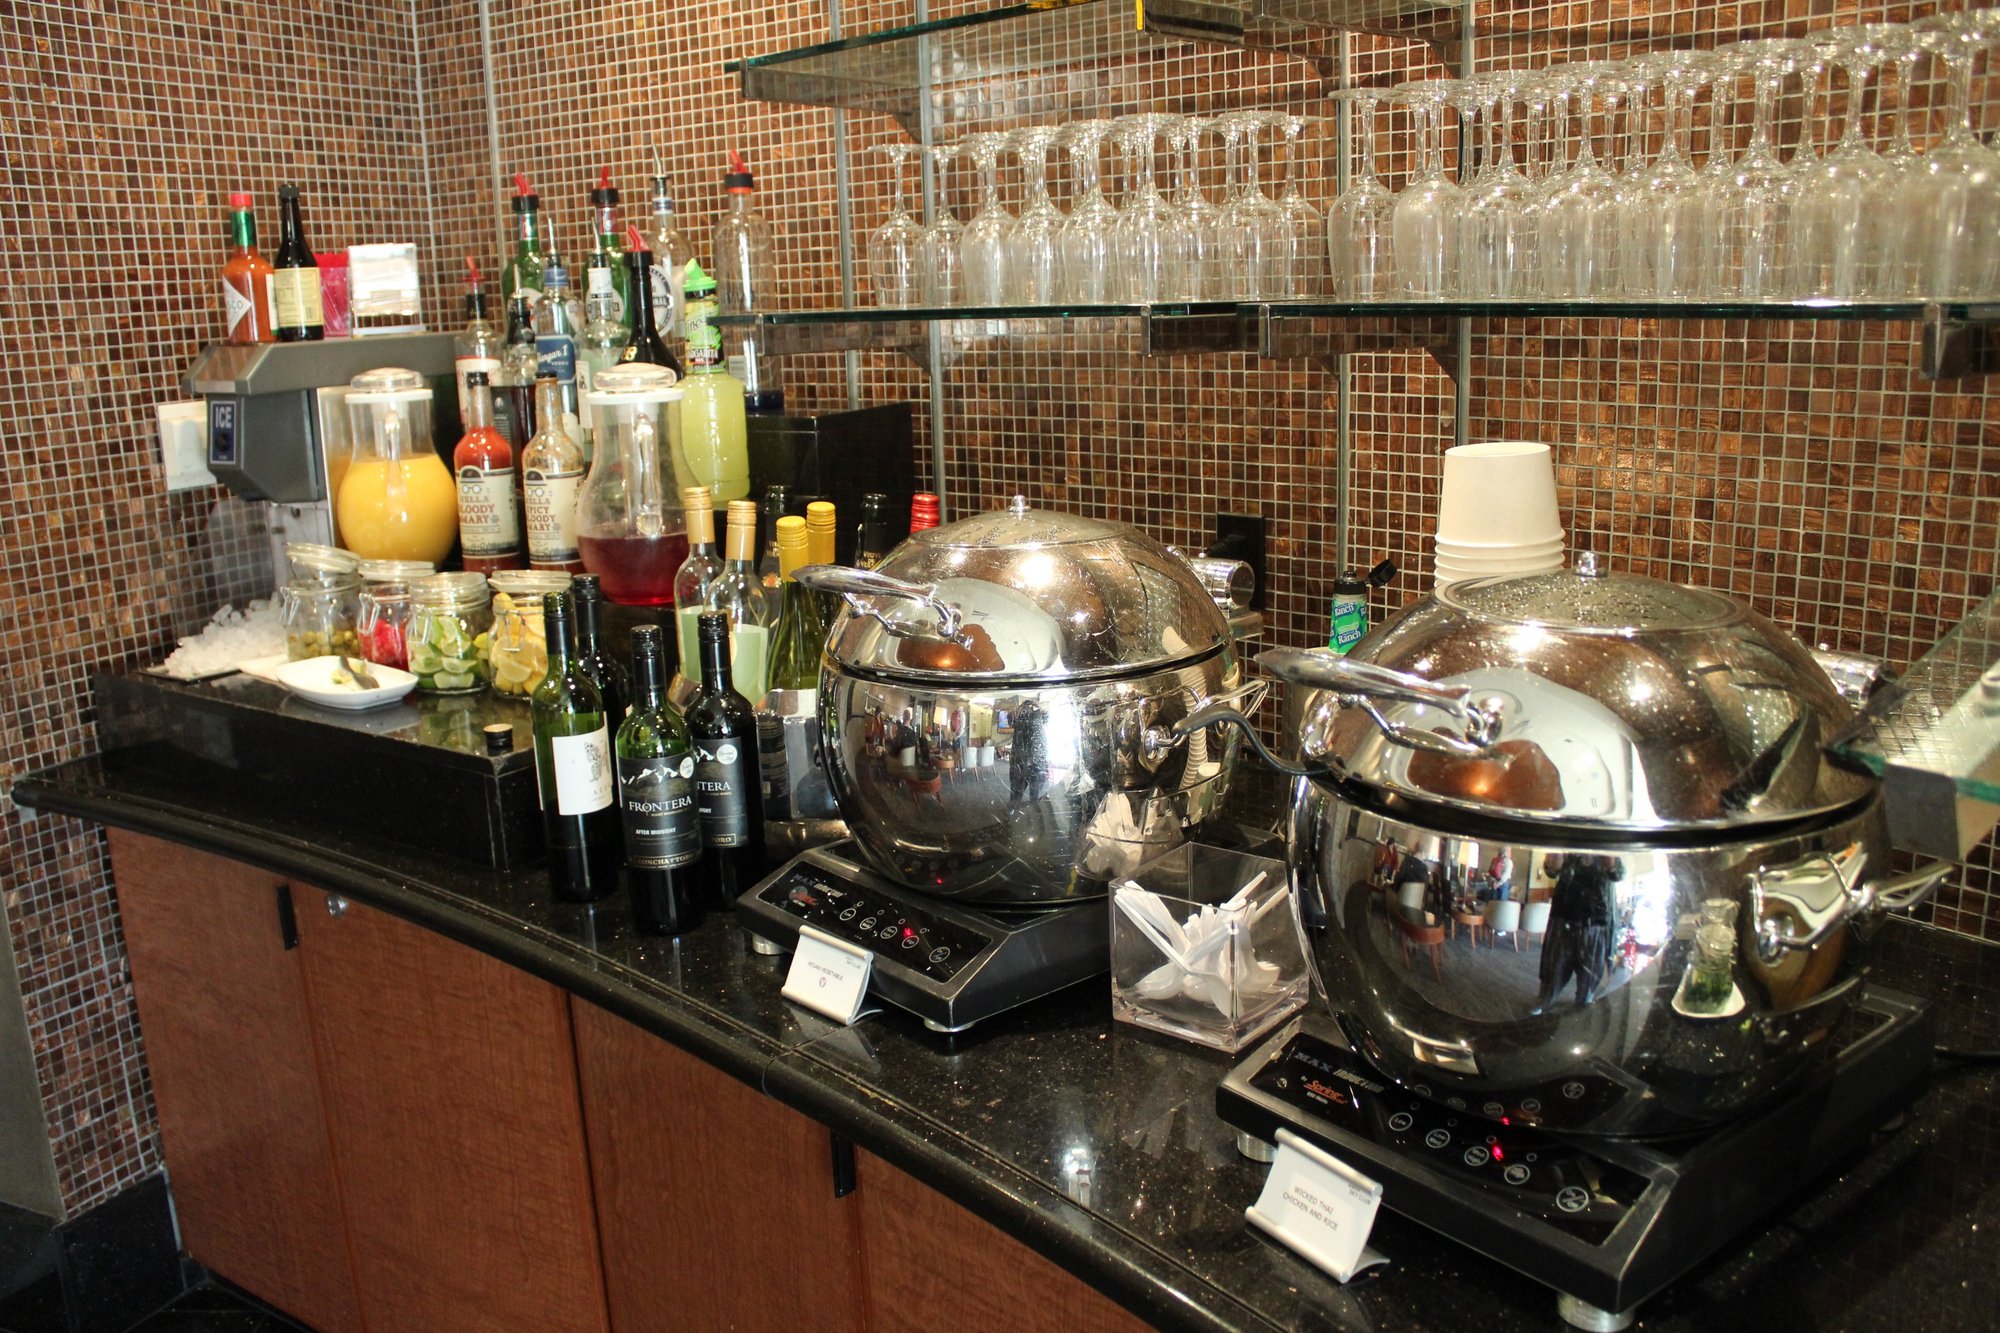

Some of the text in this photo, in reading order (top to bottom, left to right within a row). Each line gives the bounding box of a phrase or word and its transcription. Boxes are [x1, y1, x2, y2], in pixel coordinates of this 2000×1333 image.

[687, 349, 718, 358] ARGARITA
[215, 406, 232, 428] ICE
[458, 504, 495, 513] LOODY
[526, 515, 556, 523] LOODY
[1338, 629, 1361, 644] Ranch
[629, 795, 692, 813] FRONTERA
[714, 836, 731, 844] ORO
[1294, 1051, 1332, 1073] MAX
[1307, 1080, 1343, 1100] Spring
[1294, 1185, 1334, 1215] WICKED THAI
[1282, 1191, 1339, 1232] CHICKEN AND RICE
